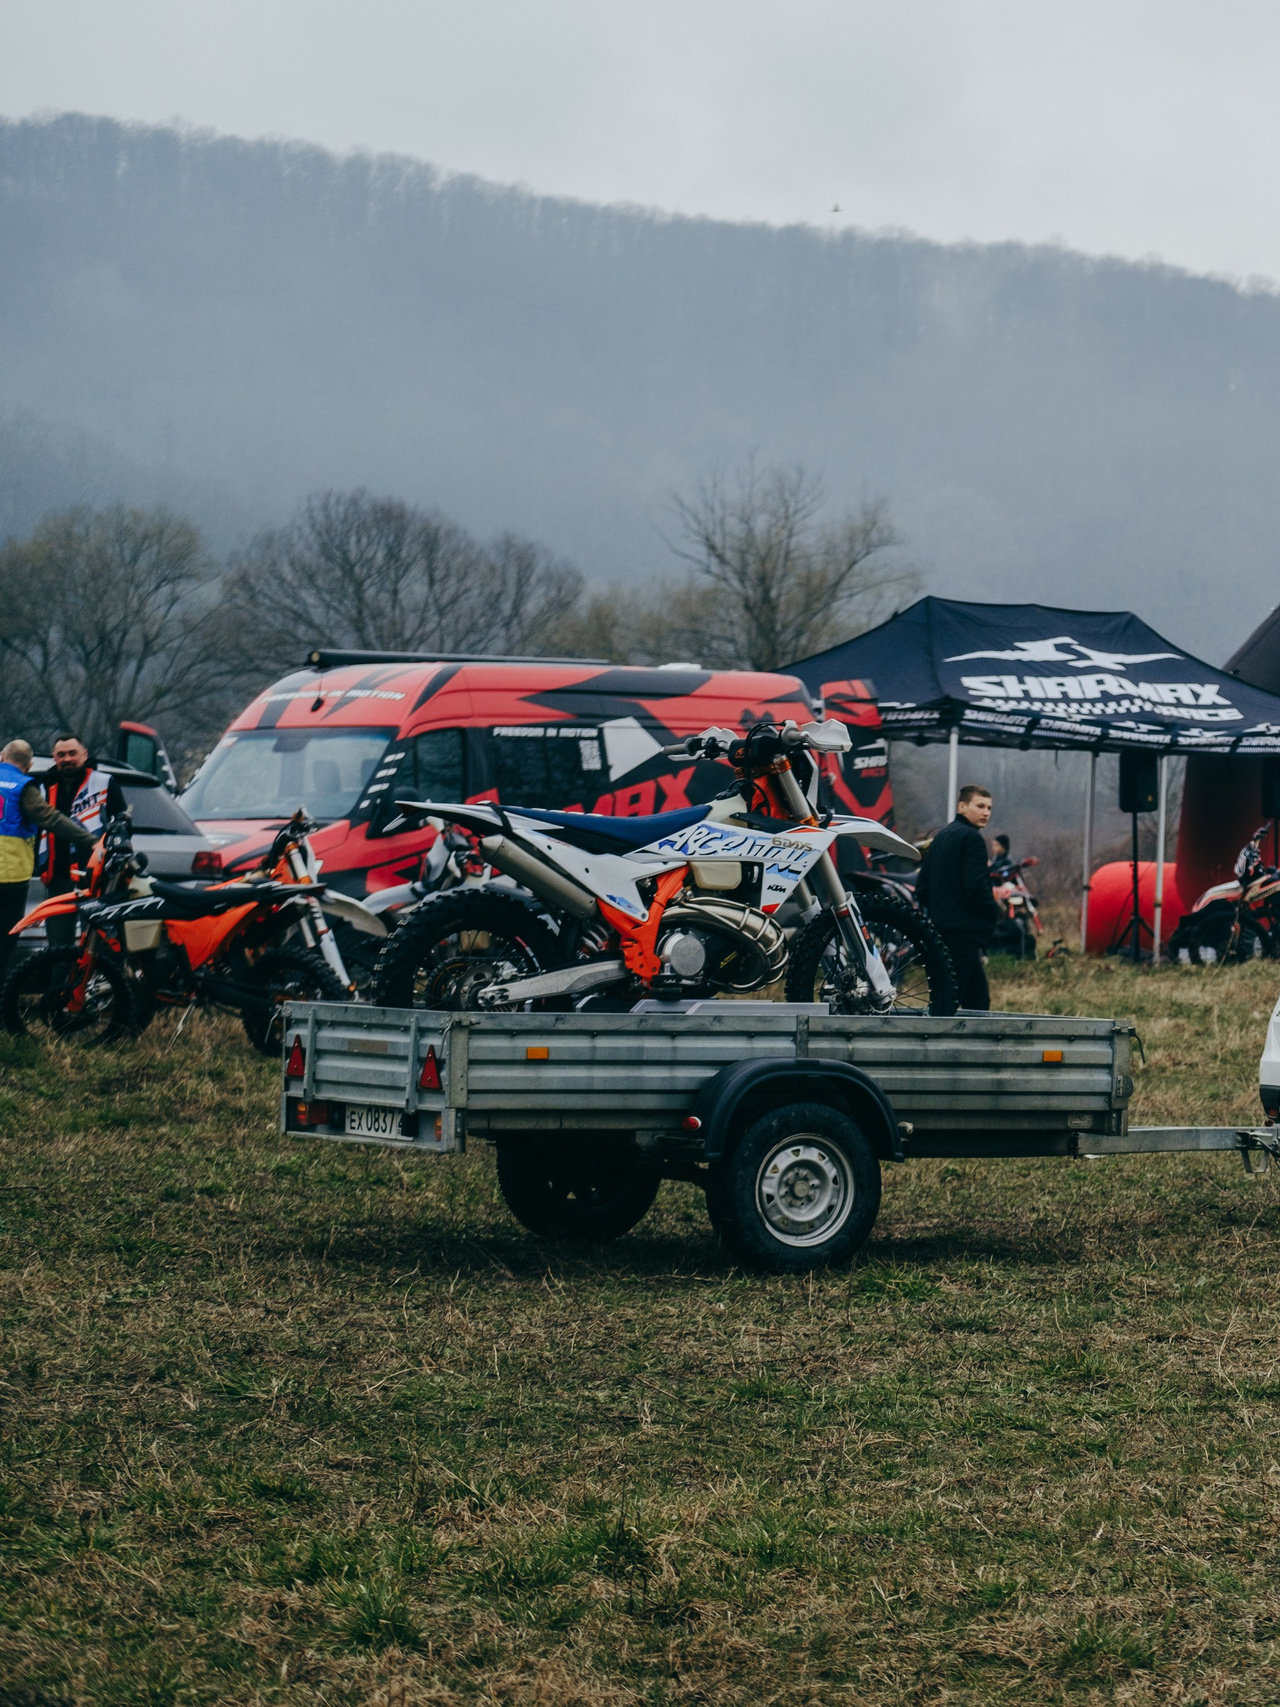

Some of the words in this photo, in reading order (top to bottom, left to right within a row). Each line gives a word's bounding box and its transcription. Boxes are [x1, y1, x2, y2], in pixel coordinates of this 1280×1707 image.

[960, 673, 1232, 706] SHARMAX
[766, 884, 788, 894] KTM
[366, 1107, 396, 1134] 0837
